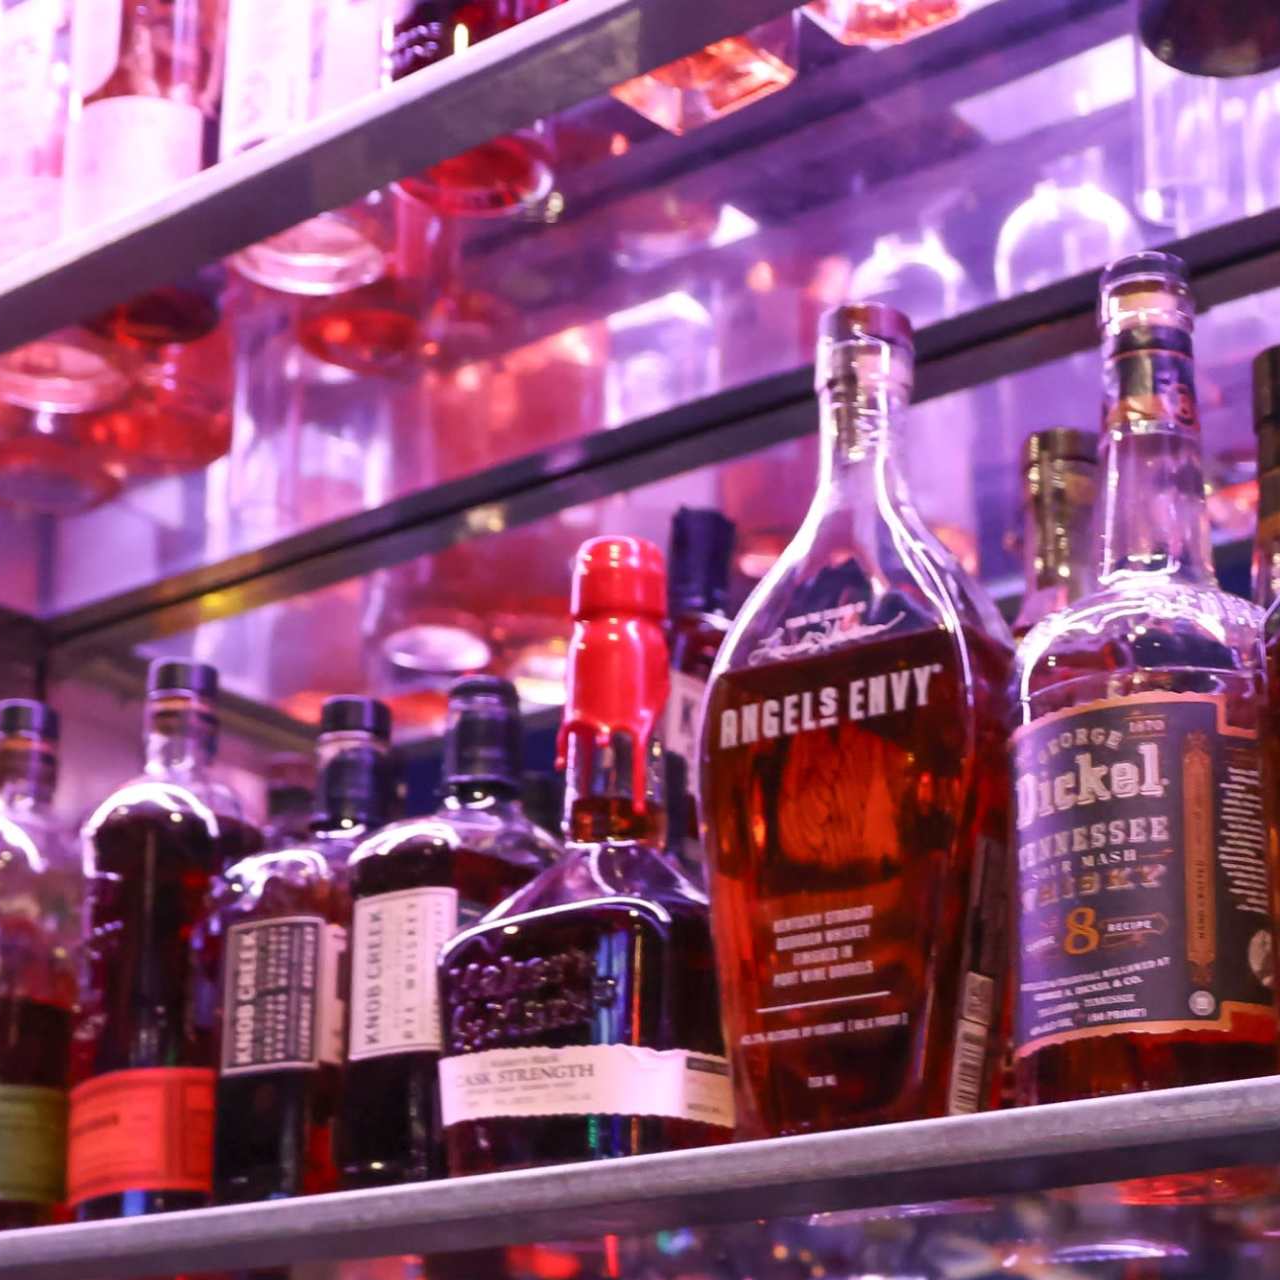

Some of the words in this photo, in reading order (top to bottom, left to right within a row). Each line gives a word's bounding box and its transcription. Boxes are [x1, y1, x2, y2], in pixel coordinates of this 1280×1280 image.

[720, 686, 840, 749] ANGELS
[848, 664, 934, 721] ENVY
[1016, 742, 1166, 830] Dickel
[1080, 848, 1138, 867] MASH
[365, 911, 384, 980] CREEK
[1062, 906, 1101, 957] 8
[1106, 919, 1153, 933] RECIPE
[237, 930, 258, 1002] CREEK
[236, 1003, 256, 1064] KNOB
[365, 984, 383, 1045] KNOB
[497, 1063, 595, 1085] STRENGTH
